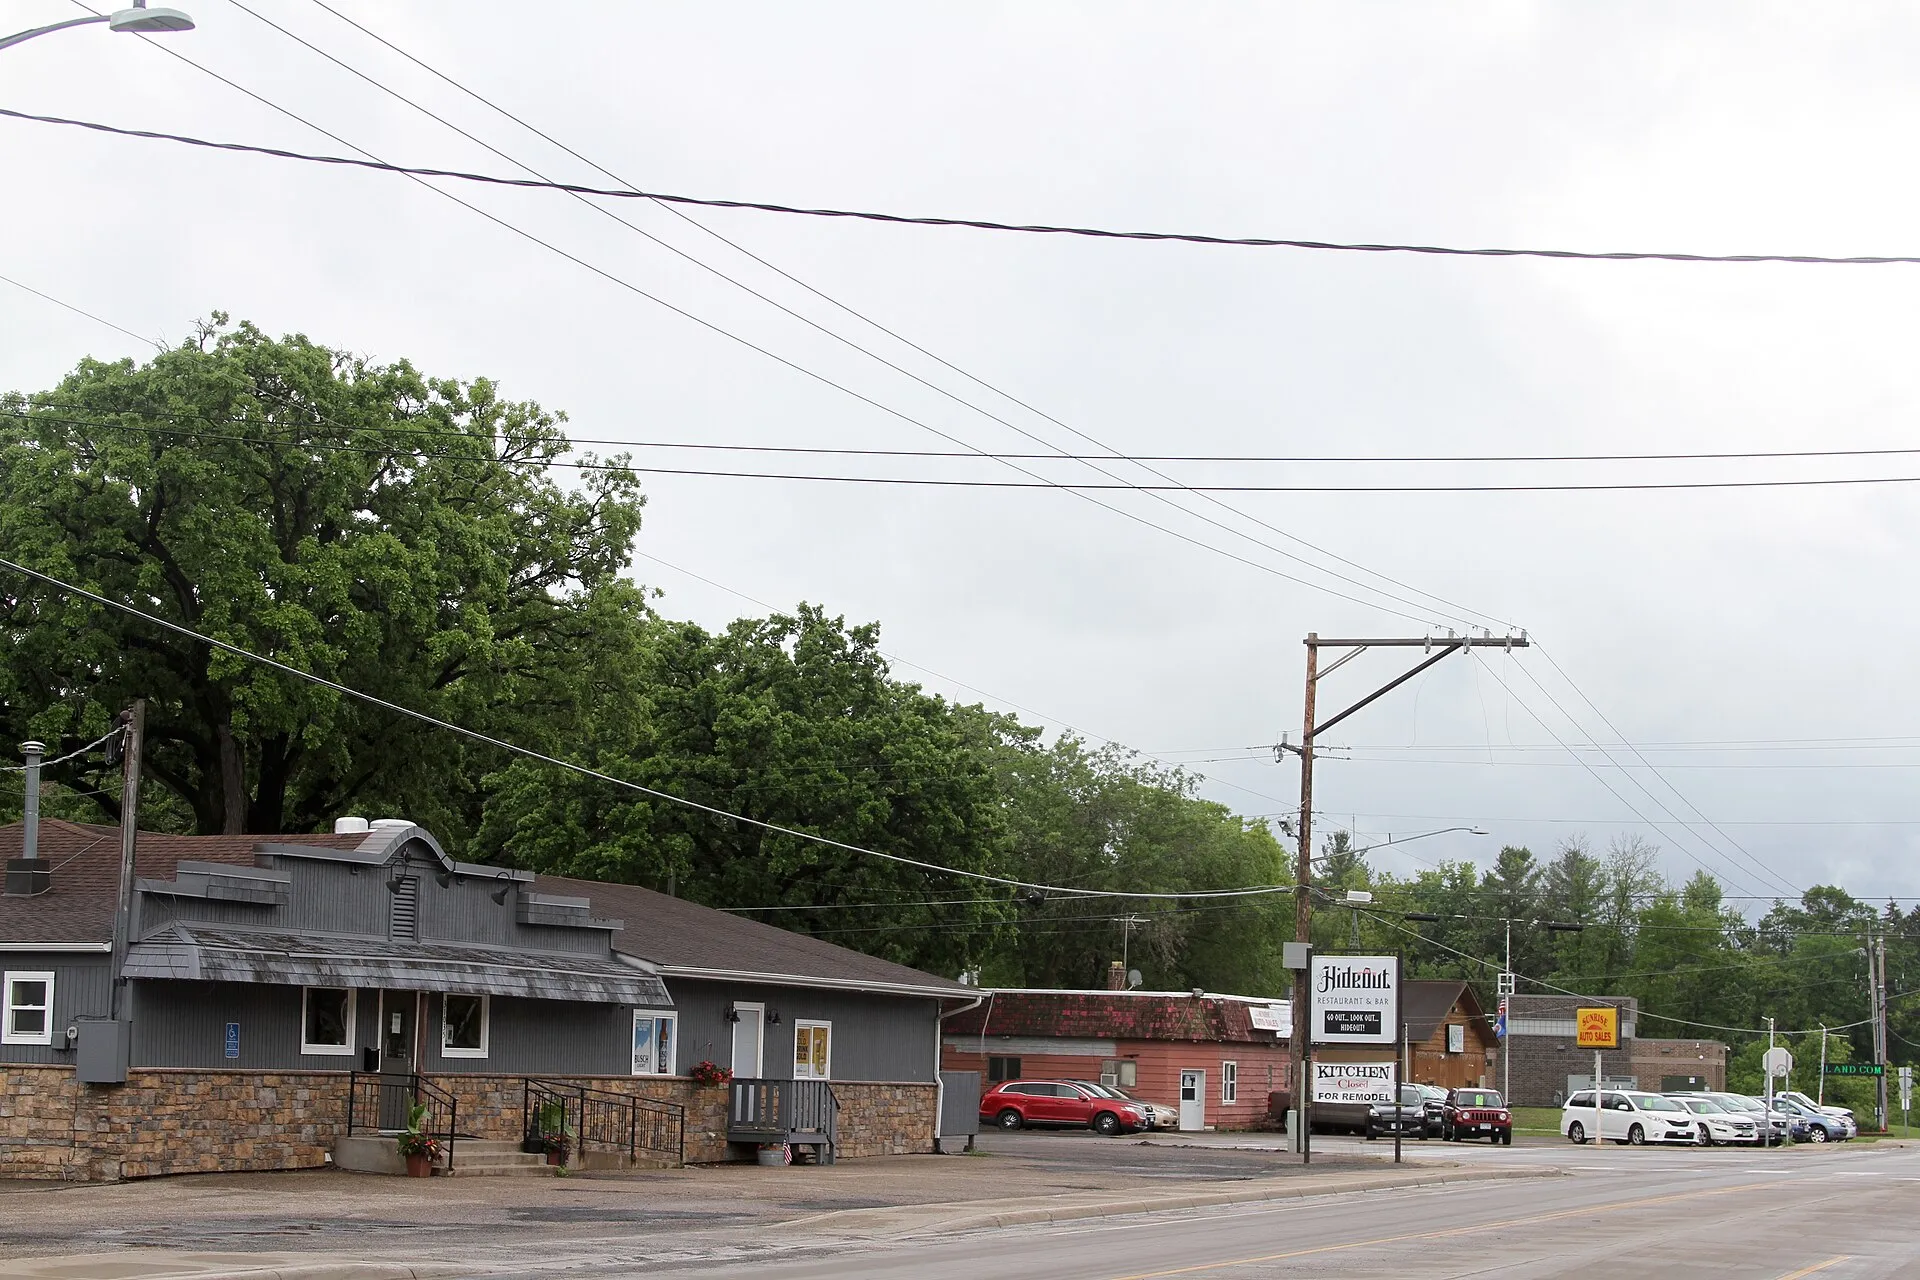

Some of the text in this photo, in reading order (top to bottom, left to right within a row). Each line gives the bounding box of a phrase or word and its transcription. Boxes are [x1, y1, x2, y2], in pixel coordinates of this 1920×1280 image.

[1317, 997, 1363, 1005] RESTAURANT
[1326, 1013, 1334, 1021] GO
[1582, 1013, 1608, 1027] SUNRISE
[1579, 1032, 1612, 1041] AUTO SALES
[1317, 1065, 1391, 1080] KITCHEN
[1337, 1080, 1369, 1089] Closed
[1318, 1092, 1391, 1101] FOR REMODEL
